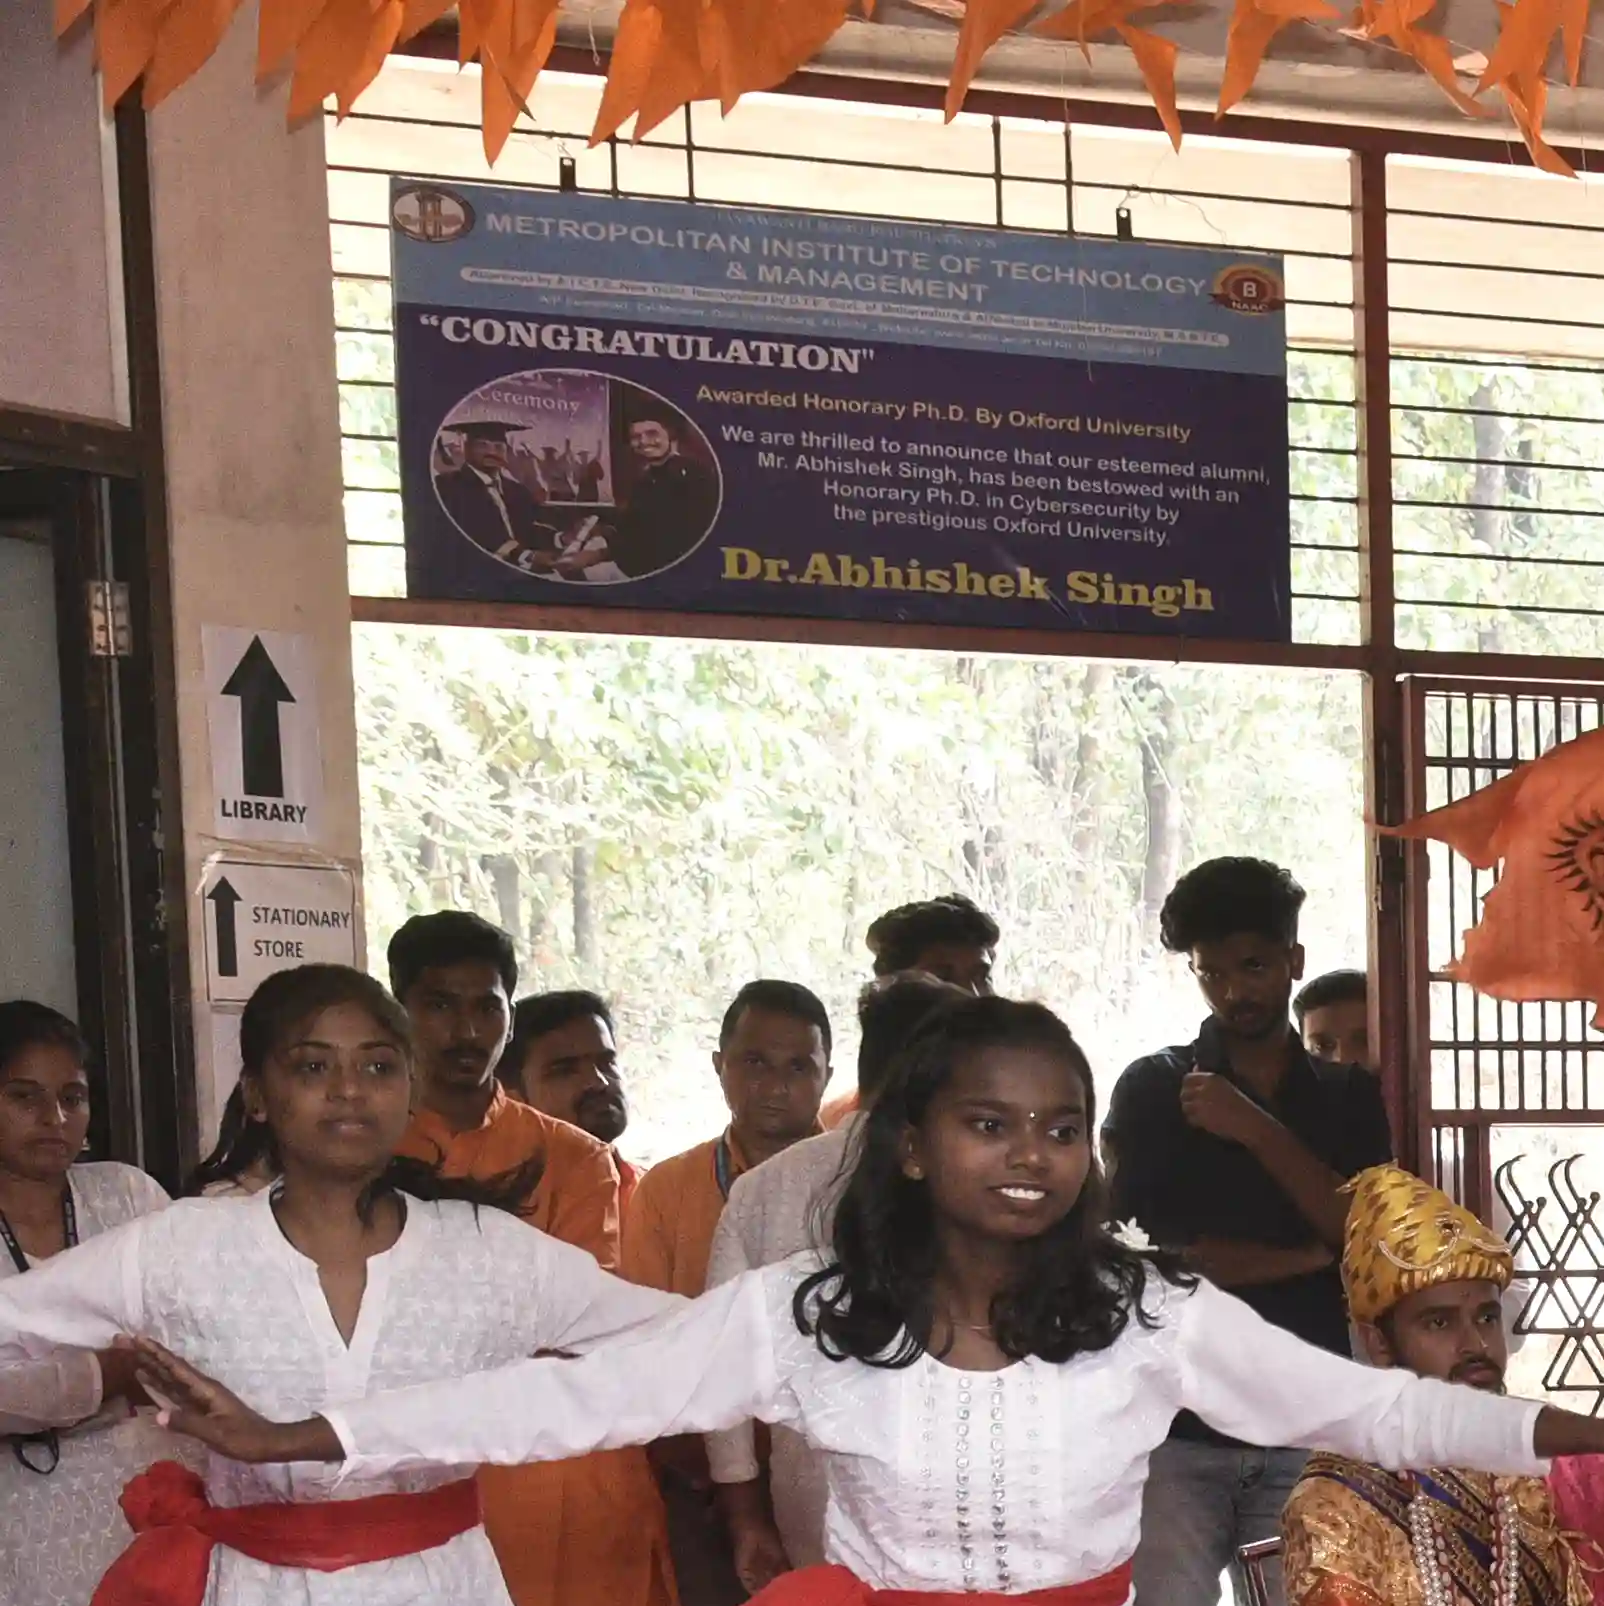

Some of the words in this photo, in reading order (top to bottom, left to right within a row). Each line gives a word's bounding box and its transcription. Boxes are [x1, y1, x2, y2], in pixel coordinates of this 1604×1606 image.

[486, 212, 751, 254] METROPOLITAN
[762, 235, 931, 272] INSTITUTE
[940, 253, 981, 275] OF
[991, 260, 1207, 297] TECHNOLOGY
[726, 261, 747, 280] &
[758, 265, 989, 303] MANAGEMENT
[697, 385, 796, 408] Awarded
[804, 393, 907, 420] Honorary
[914, 403, 969, 423] Ph.D.
[976, 407, 1002, 429] By
[1009, 410, 1080, 433] Oxford
[1087, 417, 1191, 443] University
[722, 426, 754, 445] We
[760, 432, 795, 447] are
[801, 431, 875, 453] thrilled
[881, 437, 900, 454] to
[907, 441, 1007, 463] announce
[1014, 447, 1053, 468] that
[1058, 452, 1092, 469] our
[1097, 454, 1194, 478] esteemed
[1200, 462, 1270, 485] alumni,
[758, 451, 788, 470] Mr.
[796, 453, 893, 477] Abhishek
[899, 460, 962, 485] Singh,
[969, 467, 1007, 485] has
[1013, 469, 1060, 491] been
[1066, 472, 1163, 499] bestowed
[1169, 481, 1211, 502] with
[1214, 487, 1239, 503] an
[824, 480, 919, 507] Honorary
[927, 486, 980, 507] Ph.D.
[986, 491, 1003, 508] in
[1010, 493, 1151, 523] Cybersecurity
[1157, 504, 1179, 526] by
[834, 504, 866, 523] the
[872, 508, 988, 532] prestigious
[993, 515, 1061, 537] Oxford
[1067, 519, 1171, 546] University.
[721, 546, 1050, 601] Dr.Abhishek
[1066, 569, 1214, 617] Singh
[221, 799, 308, 823] LIBRARY
[253, 906, 351, 928] STATIONARY
[254, 939, 304, 958] STORE
